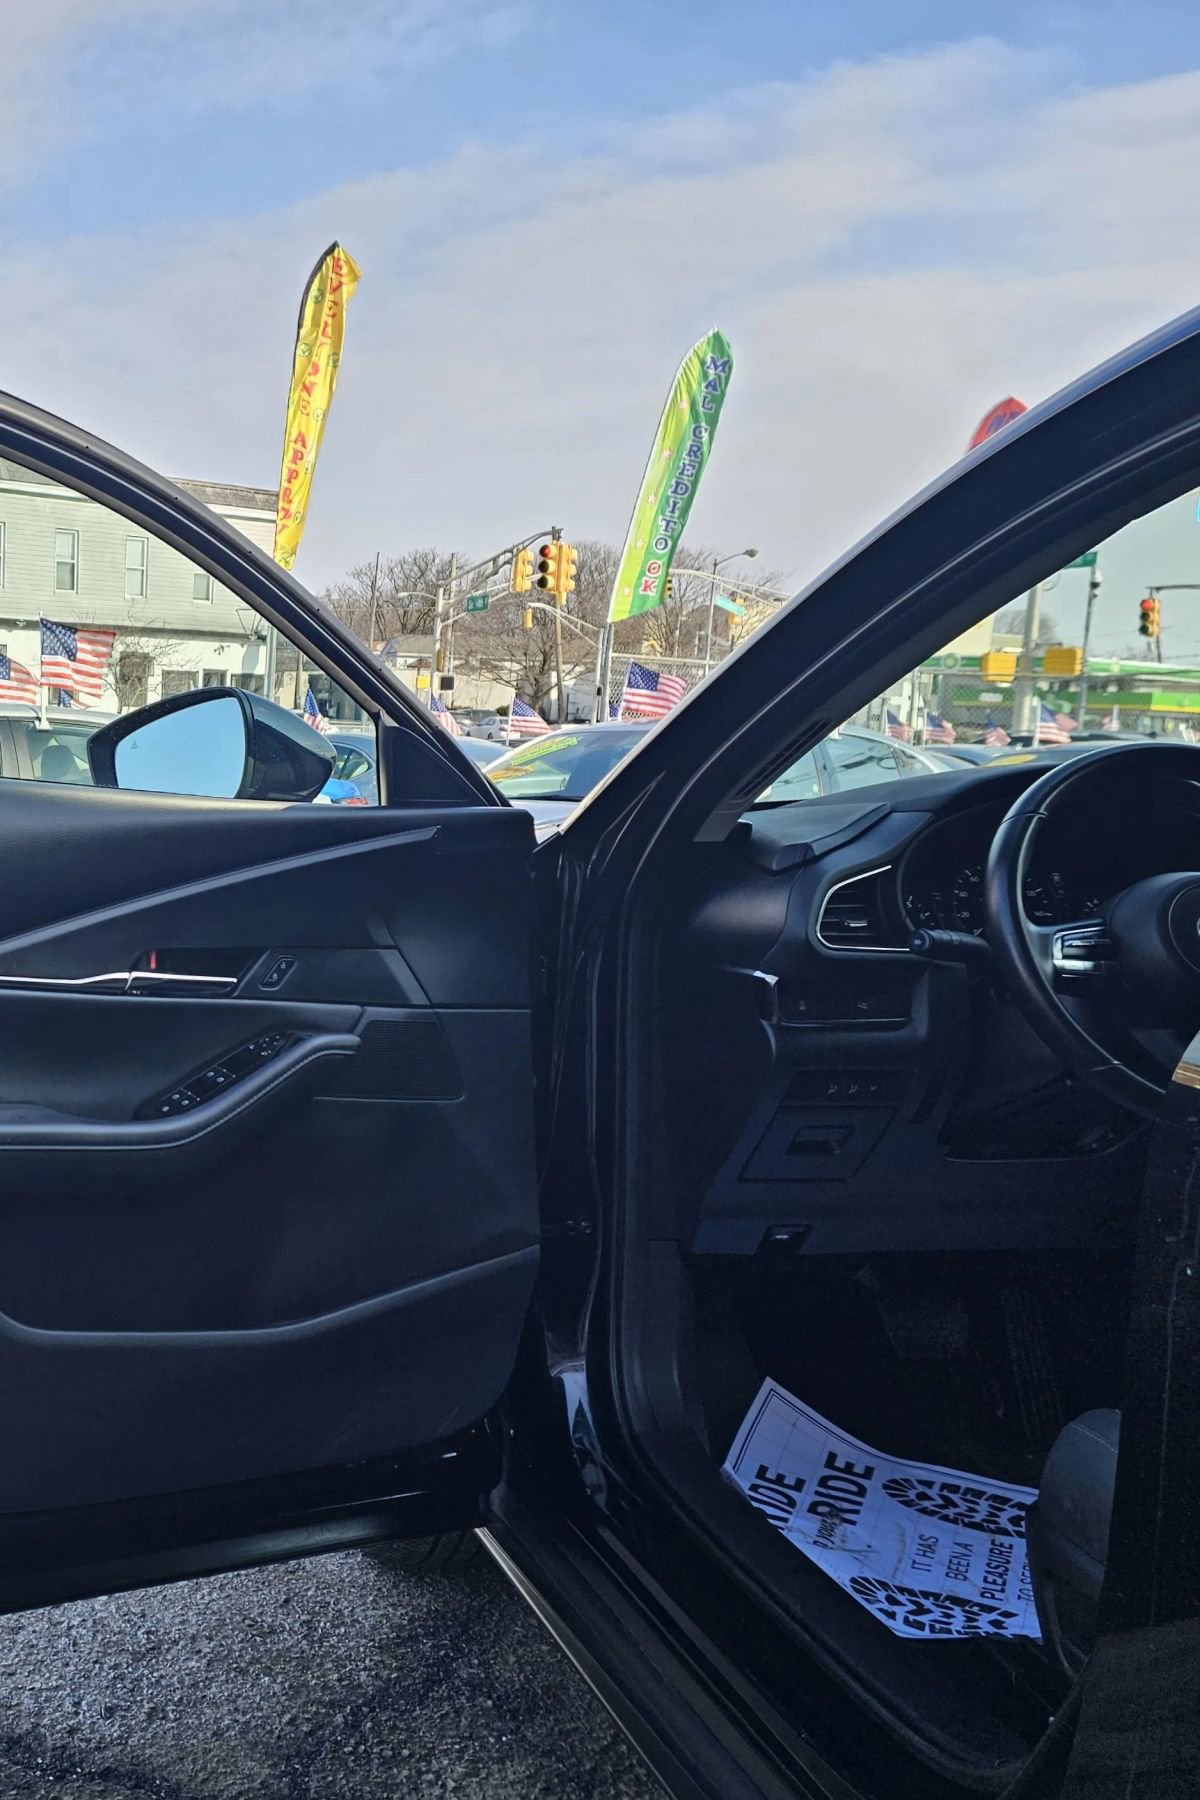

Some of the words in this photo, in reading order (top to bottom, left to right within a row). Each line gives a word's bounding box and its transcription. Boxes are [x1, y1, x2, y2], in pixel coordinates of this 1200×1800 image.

[700, 355, 731, 412] MAL
[654, 423, 709, 552] CREDITO
[640, 561, 662, 597] OK
[806, 1451, 875, 1527] RIDE
[915, 1534, 939, 1560] HAS
[953, 1541, 974, 1553] A
[911, 1559, 933, 1573] IT
[945, 1551, 972, 1582] BEEN
[980, 1538, 1014, 1602] PLEASURE
